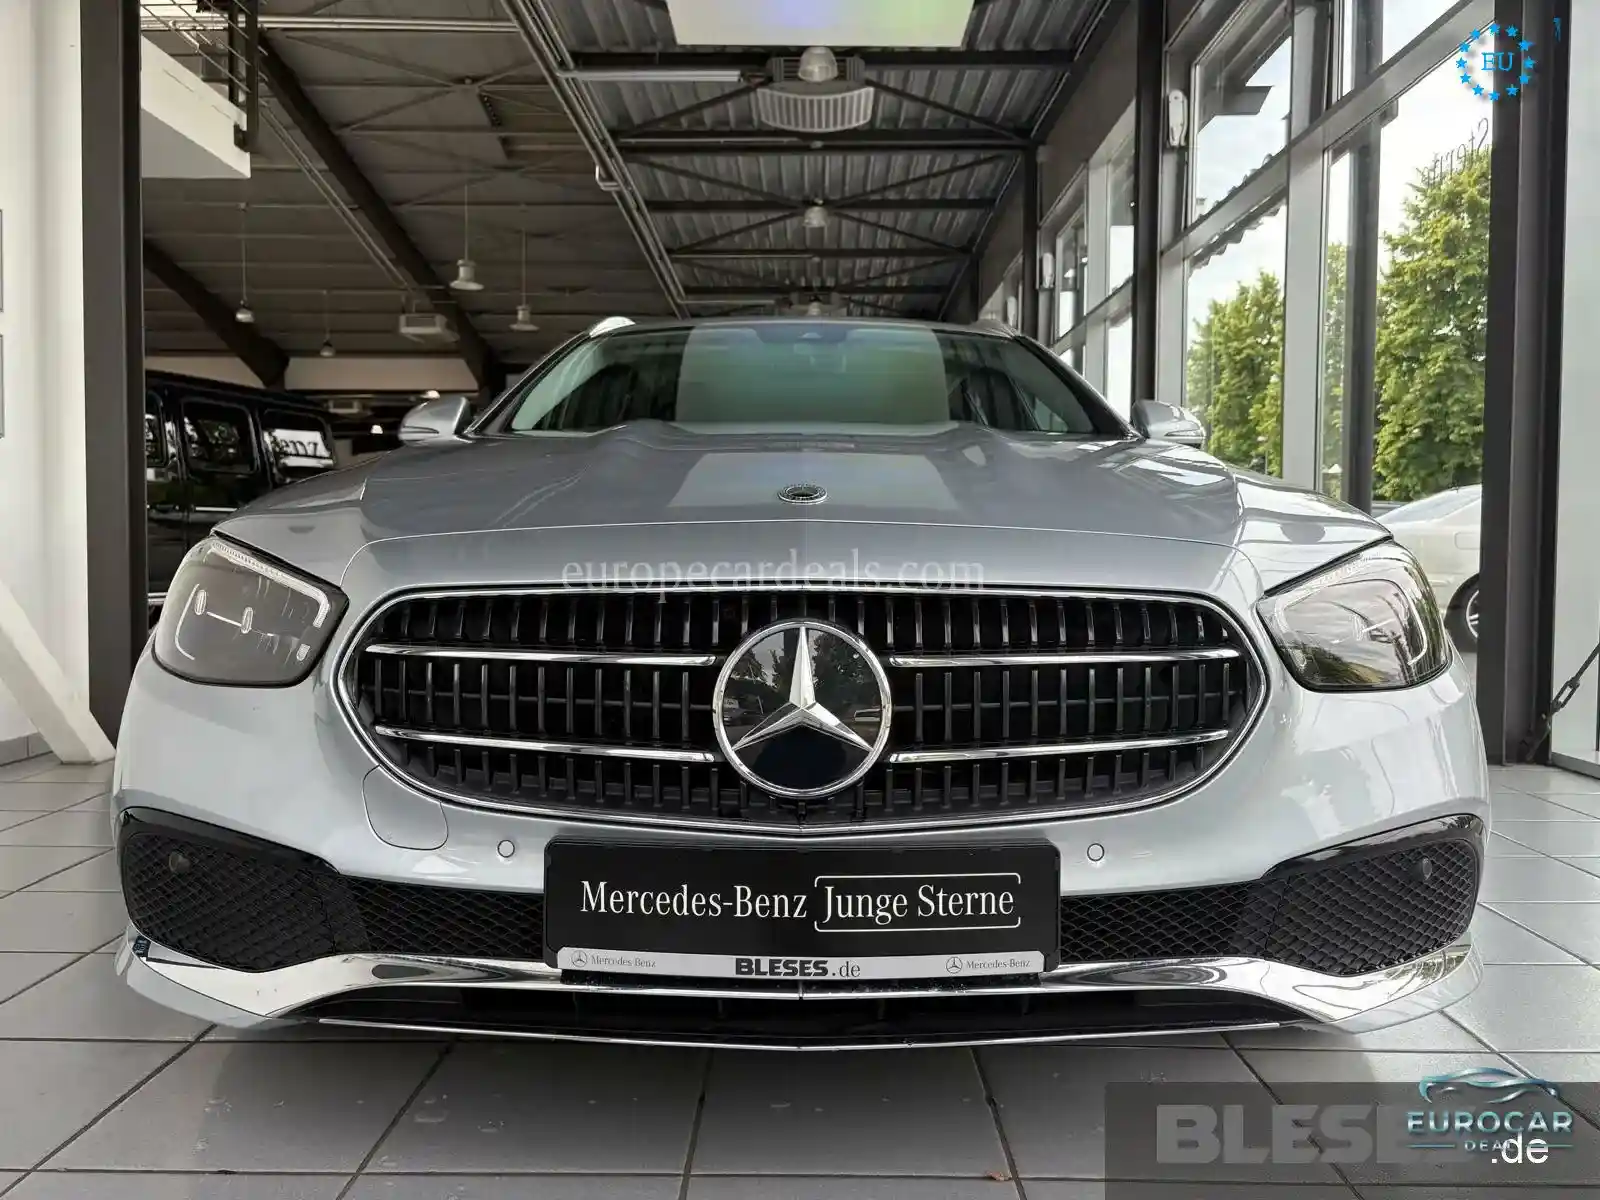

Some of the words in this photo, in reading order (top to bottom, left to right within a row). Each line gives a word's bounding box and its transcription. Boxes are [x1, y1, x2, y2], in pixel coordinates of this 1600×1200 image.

[580, 880, 808, 919] Mercedes-Benz
[822, 886, 908, 926] Junge
[917, 884, 1014, 918] Sterne
[591, 953, 657, 968] MercedesBenz
[735, 957, 861, 978] BLESES.de
[966, 958, 1031, 970] Mercedes-Benz
